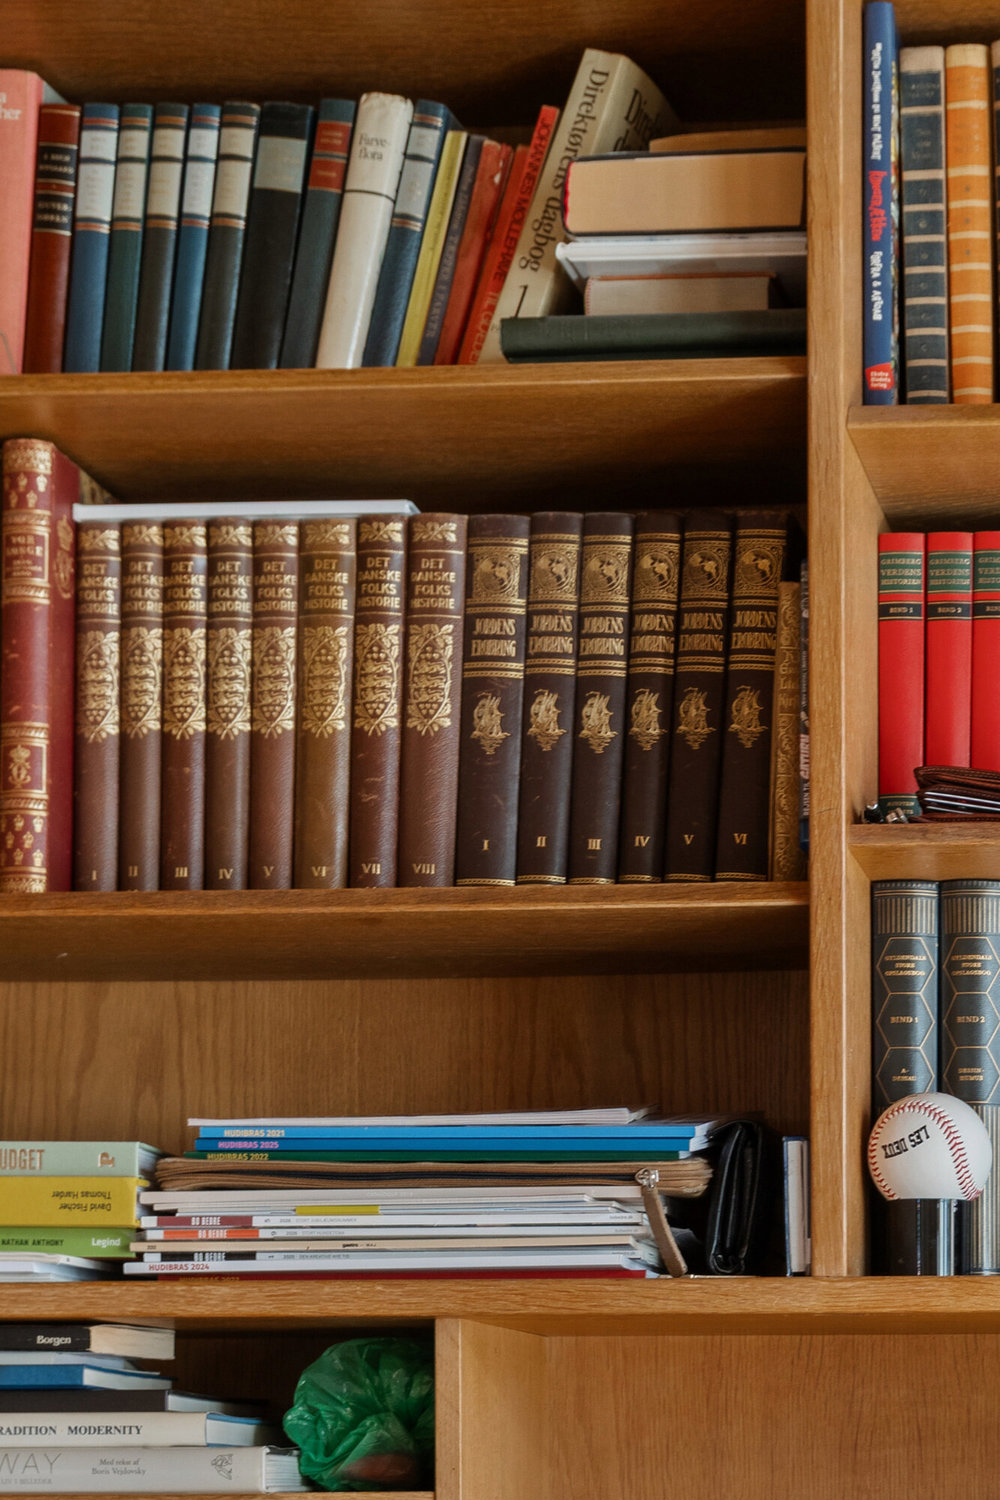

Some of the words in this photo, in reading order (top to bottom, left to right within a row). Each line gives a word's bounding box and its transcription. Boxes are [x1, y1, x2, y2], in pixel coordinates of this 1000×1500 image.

[519, 118, 552, 195] JOHANNES
[519, 197, 562, 274] dagbog
[171, 561, 194, 573] DET
[315, 559, 338, 570] DET
[366, 556, 391, 568] DET
[421, 558, 445, 569] DET
[167, 587, 202, 599] FOLKS
[309, 585, 344, 597] FOLKS
[361, 583, 397, 595] FOLKS
[415, 584, 451, 596] FOLKS
[536, 835, 547, 848] II
[587, 838, 602, 850] III
[633, 835, 651, 848] IV
[683, 833, 695, 846] V
[733, 832, 748, 845] VI
[482, 839, 490, 851] I
[175, 866, 188, 878] III
[311, 865, 328, 877] VI
[361, 862, 381, 875] VII
[412, 863, 435, 875] VIII
[956, 1015, 979, 1023] BIND
[980, 1015, 986, 1023] 2
[223, 1129, 265, 1137] HUDIBRAS
[266, 1129, 286, 1137] 2021
[908, 1124, 930, 1148] LES
[218, 1141, 258, 1149] HUDIBRAS
[259, 1141, 279, 1149] 2025
[881, 1137, 909, 1159] DEUX
[0, 1149, 45, 1171] UDGET
[206, 1153, 248, 1161] HUDIBRAS
[51, 1190, 79, 1199] Harder
[80, 1190, 112, 1200] Thomas
[58, 1202, 88, 1212] Fischer
[89, 1202, 112, 1212] David
[1, 1238, 29, 1247] NATHAN
[31, 1238, 65, 1247] ANTHONY
[91, 1237, 121, 1249] Legind
[149, 1263, 189, 1271] HUDIBRAS
[190, 1263, 210, 1271] 2024
[36, 1335, 72, 1347] Borgen
[66, 1425, 144, 1436] MODERNITY
[0, 1452, 63, 1475] WAY
[100, 1458, 114, 1466] Med
[91, 1468, 111, 1476] Boris
